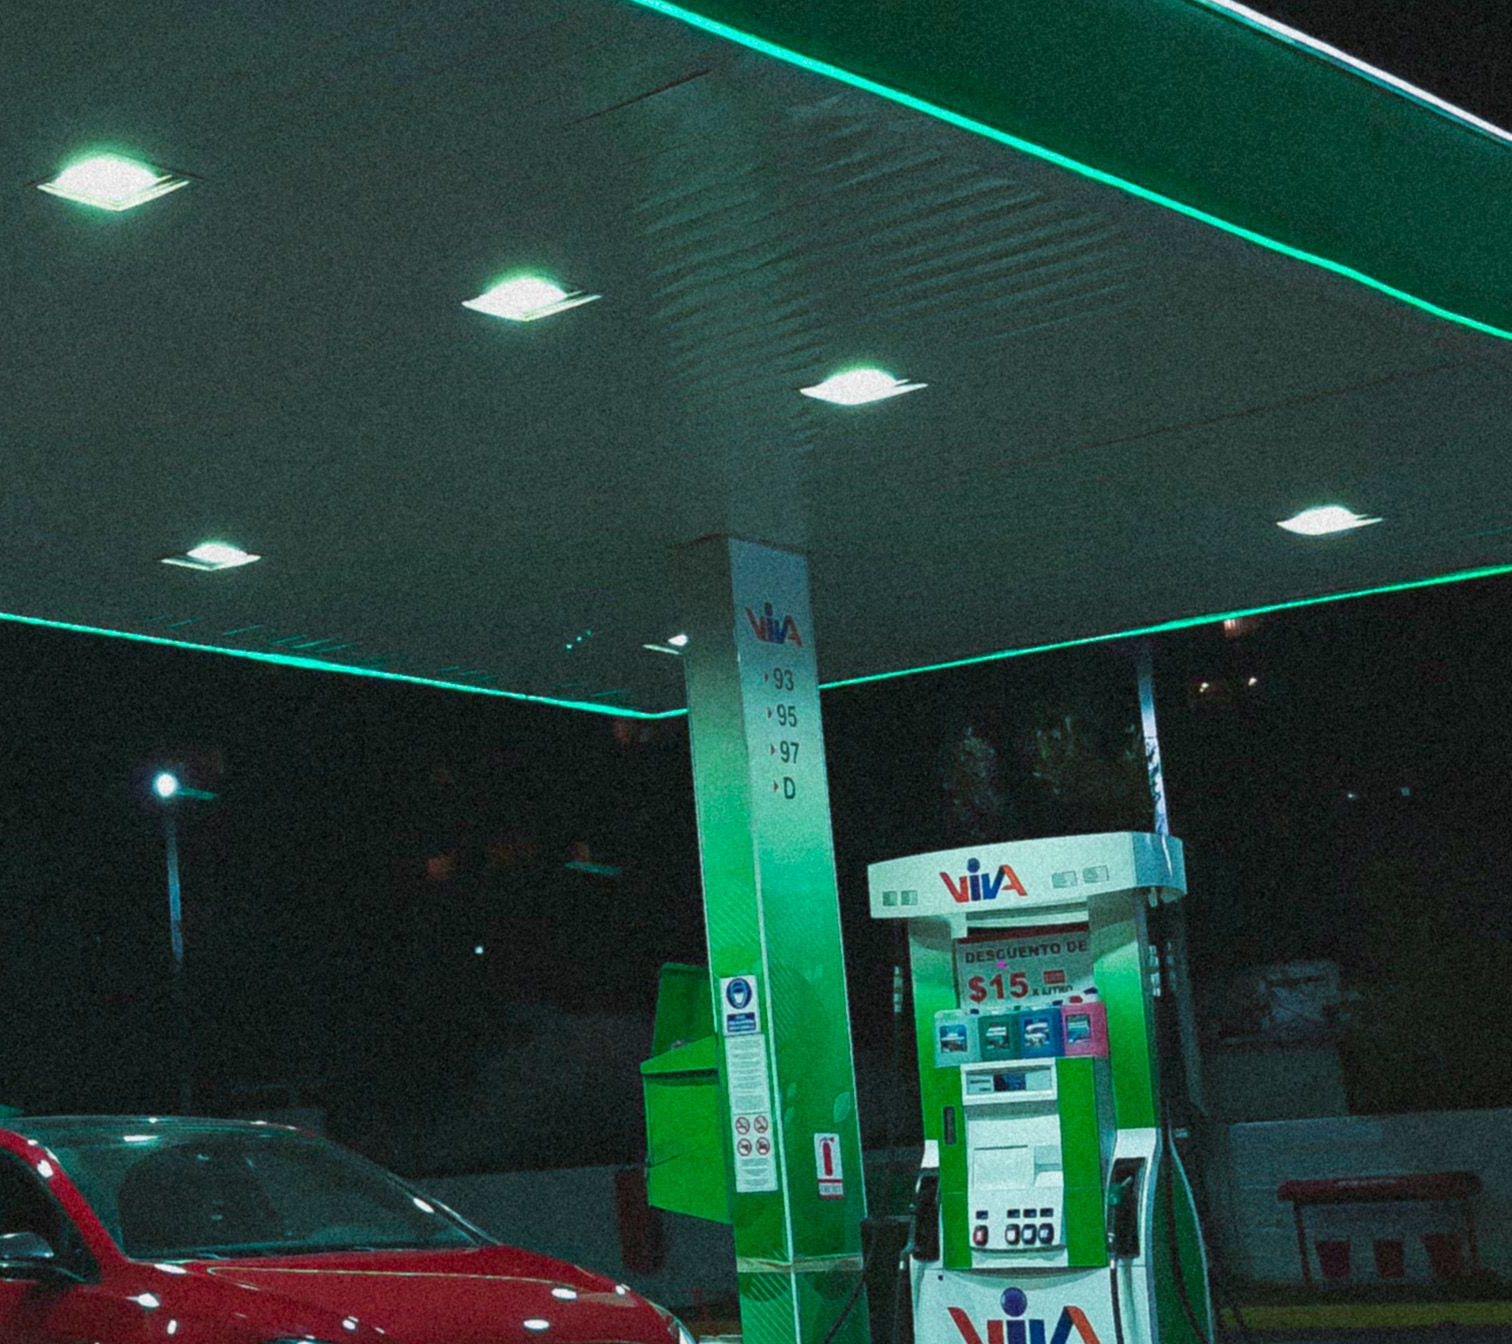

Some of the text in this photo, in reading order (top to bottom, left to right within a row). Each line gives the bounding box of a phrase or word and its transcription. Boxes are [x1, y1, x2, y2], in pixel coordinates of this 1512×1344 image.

[773, 667, 794, 691] 93
[776, 703, 798, 728] 95
[779, 740, 799, 765] 97
[783, 776, 797, 800] D
[964, 939, 1088, 964] DESCUENTO DE
[967, 971, 1029, 1004] $15
